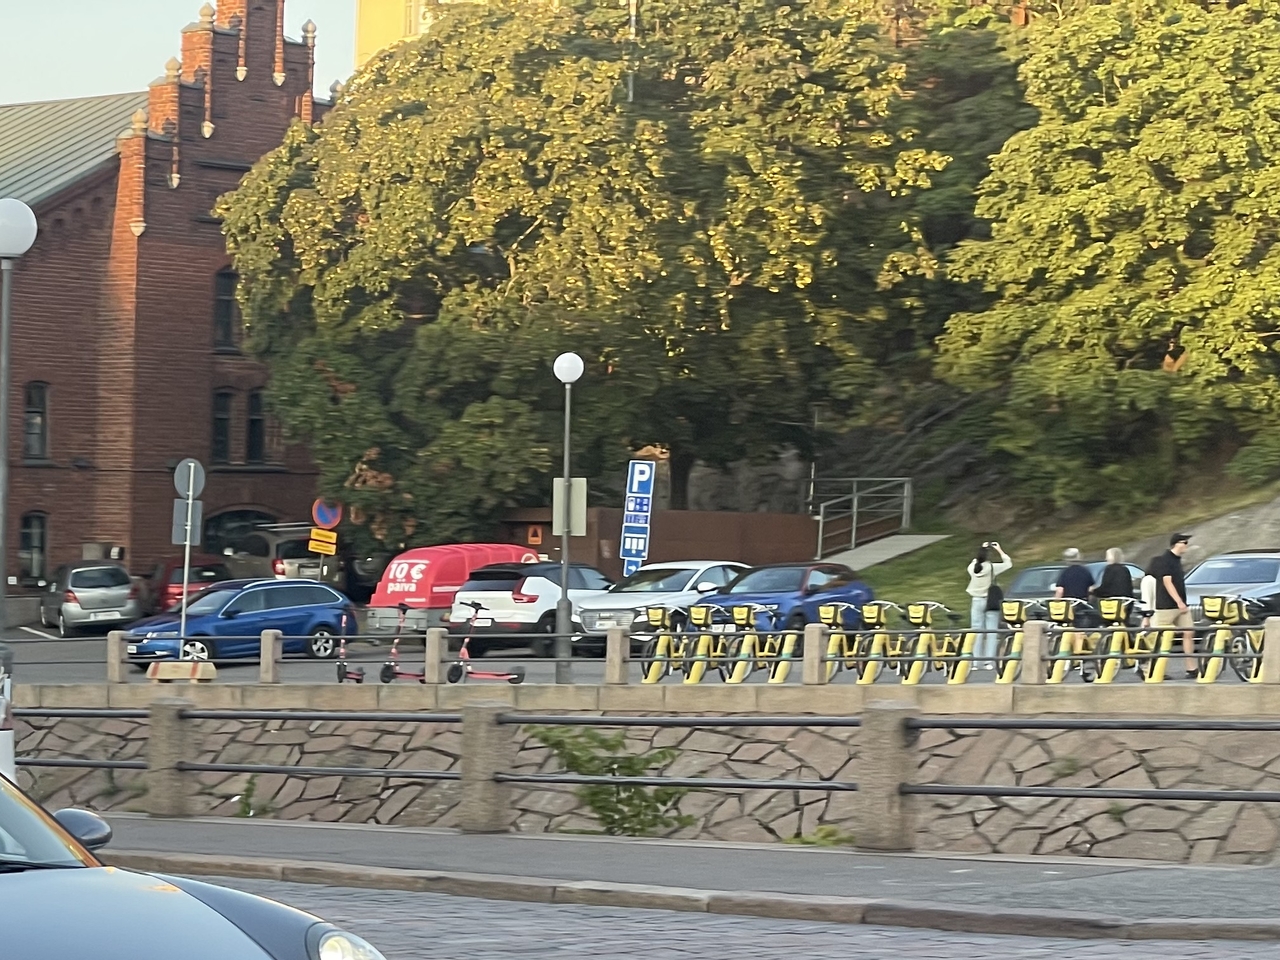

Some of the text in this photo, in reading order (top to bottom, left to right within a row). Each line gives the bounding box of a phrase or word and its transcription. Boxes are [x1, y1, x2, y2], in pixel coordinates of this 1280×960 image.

[632, 463, 651, 492] P
[389, 563, 427, 580] 10 €
